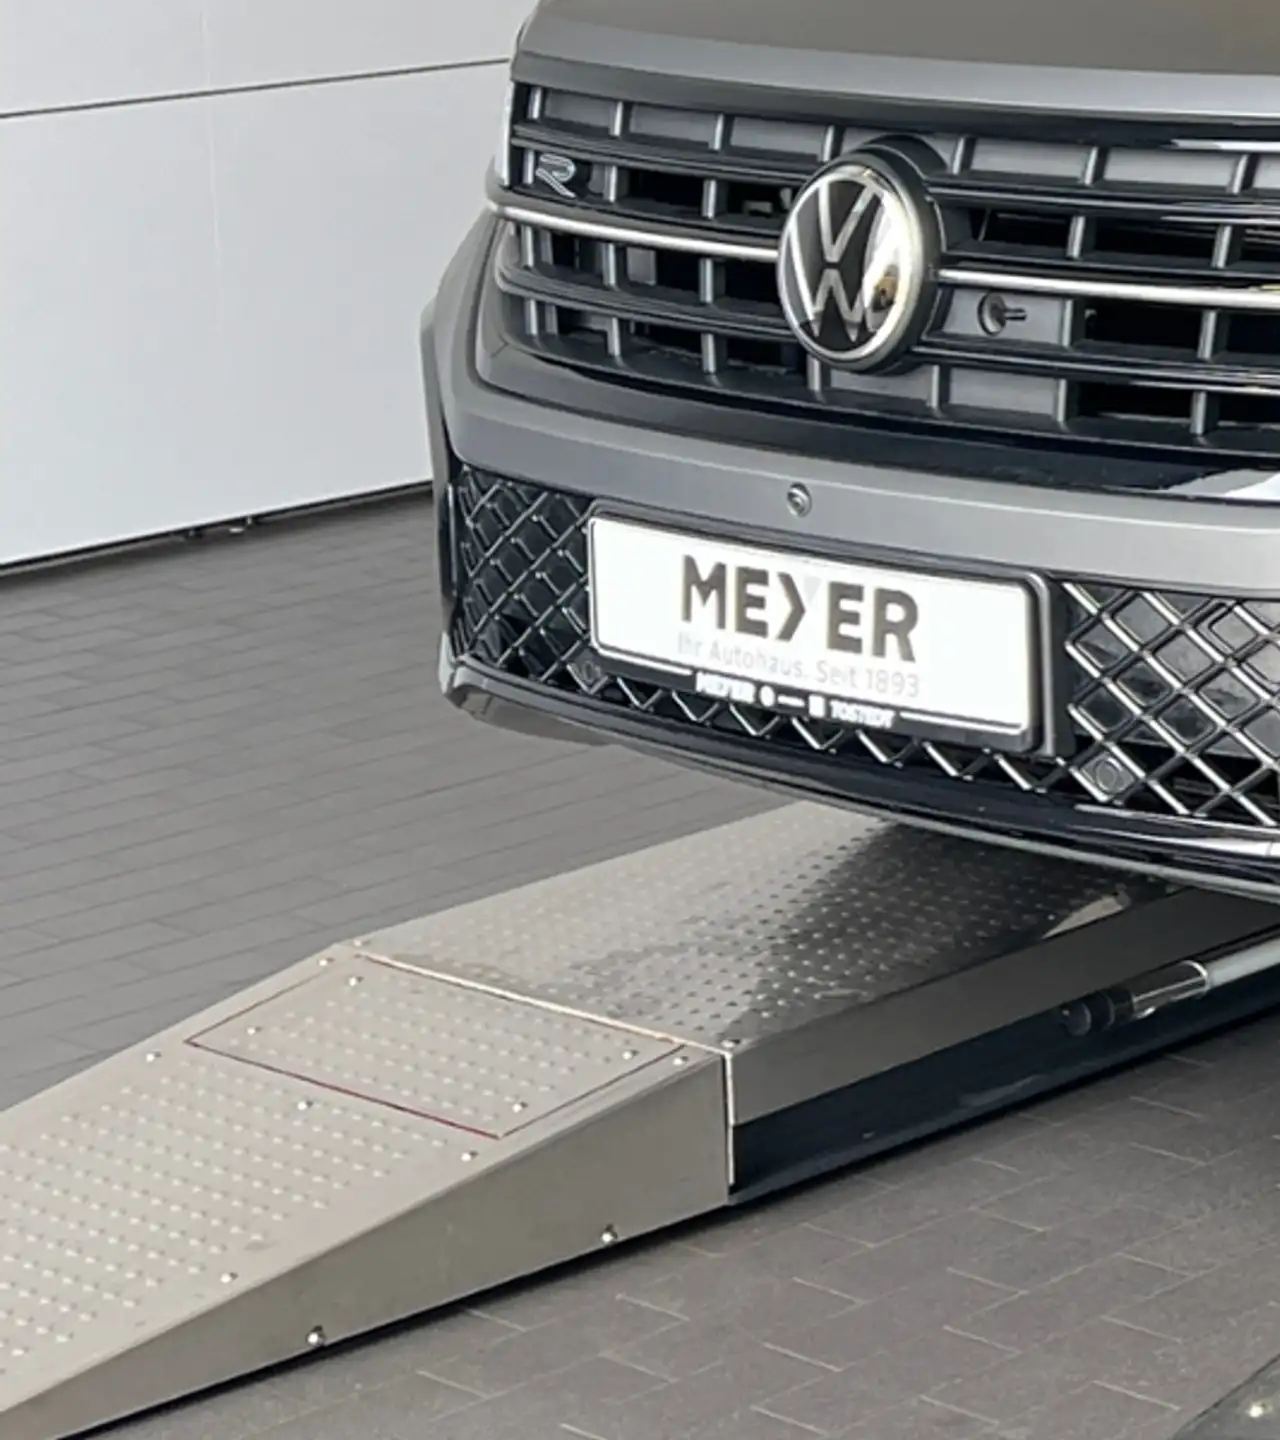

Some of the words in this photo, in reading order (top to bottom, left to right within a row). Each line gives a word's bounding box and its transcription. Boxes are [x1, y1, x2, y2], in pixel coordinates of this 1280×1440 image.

[535, 153, 576, 198] R
[780, 166, 920, 360] VW
[682, 555, 918, 663] MEYER
[816, 659, 857, 689] Seit
[866, 667, 920, 699] 1893
